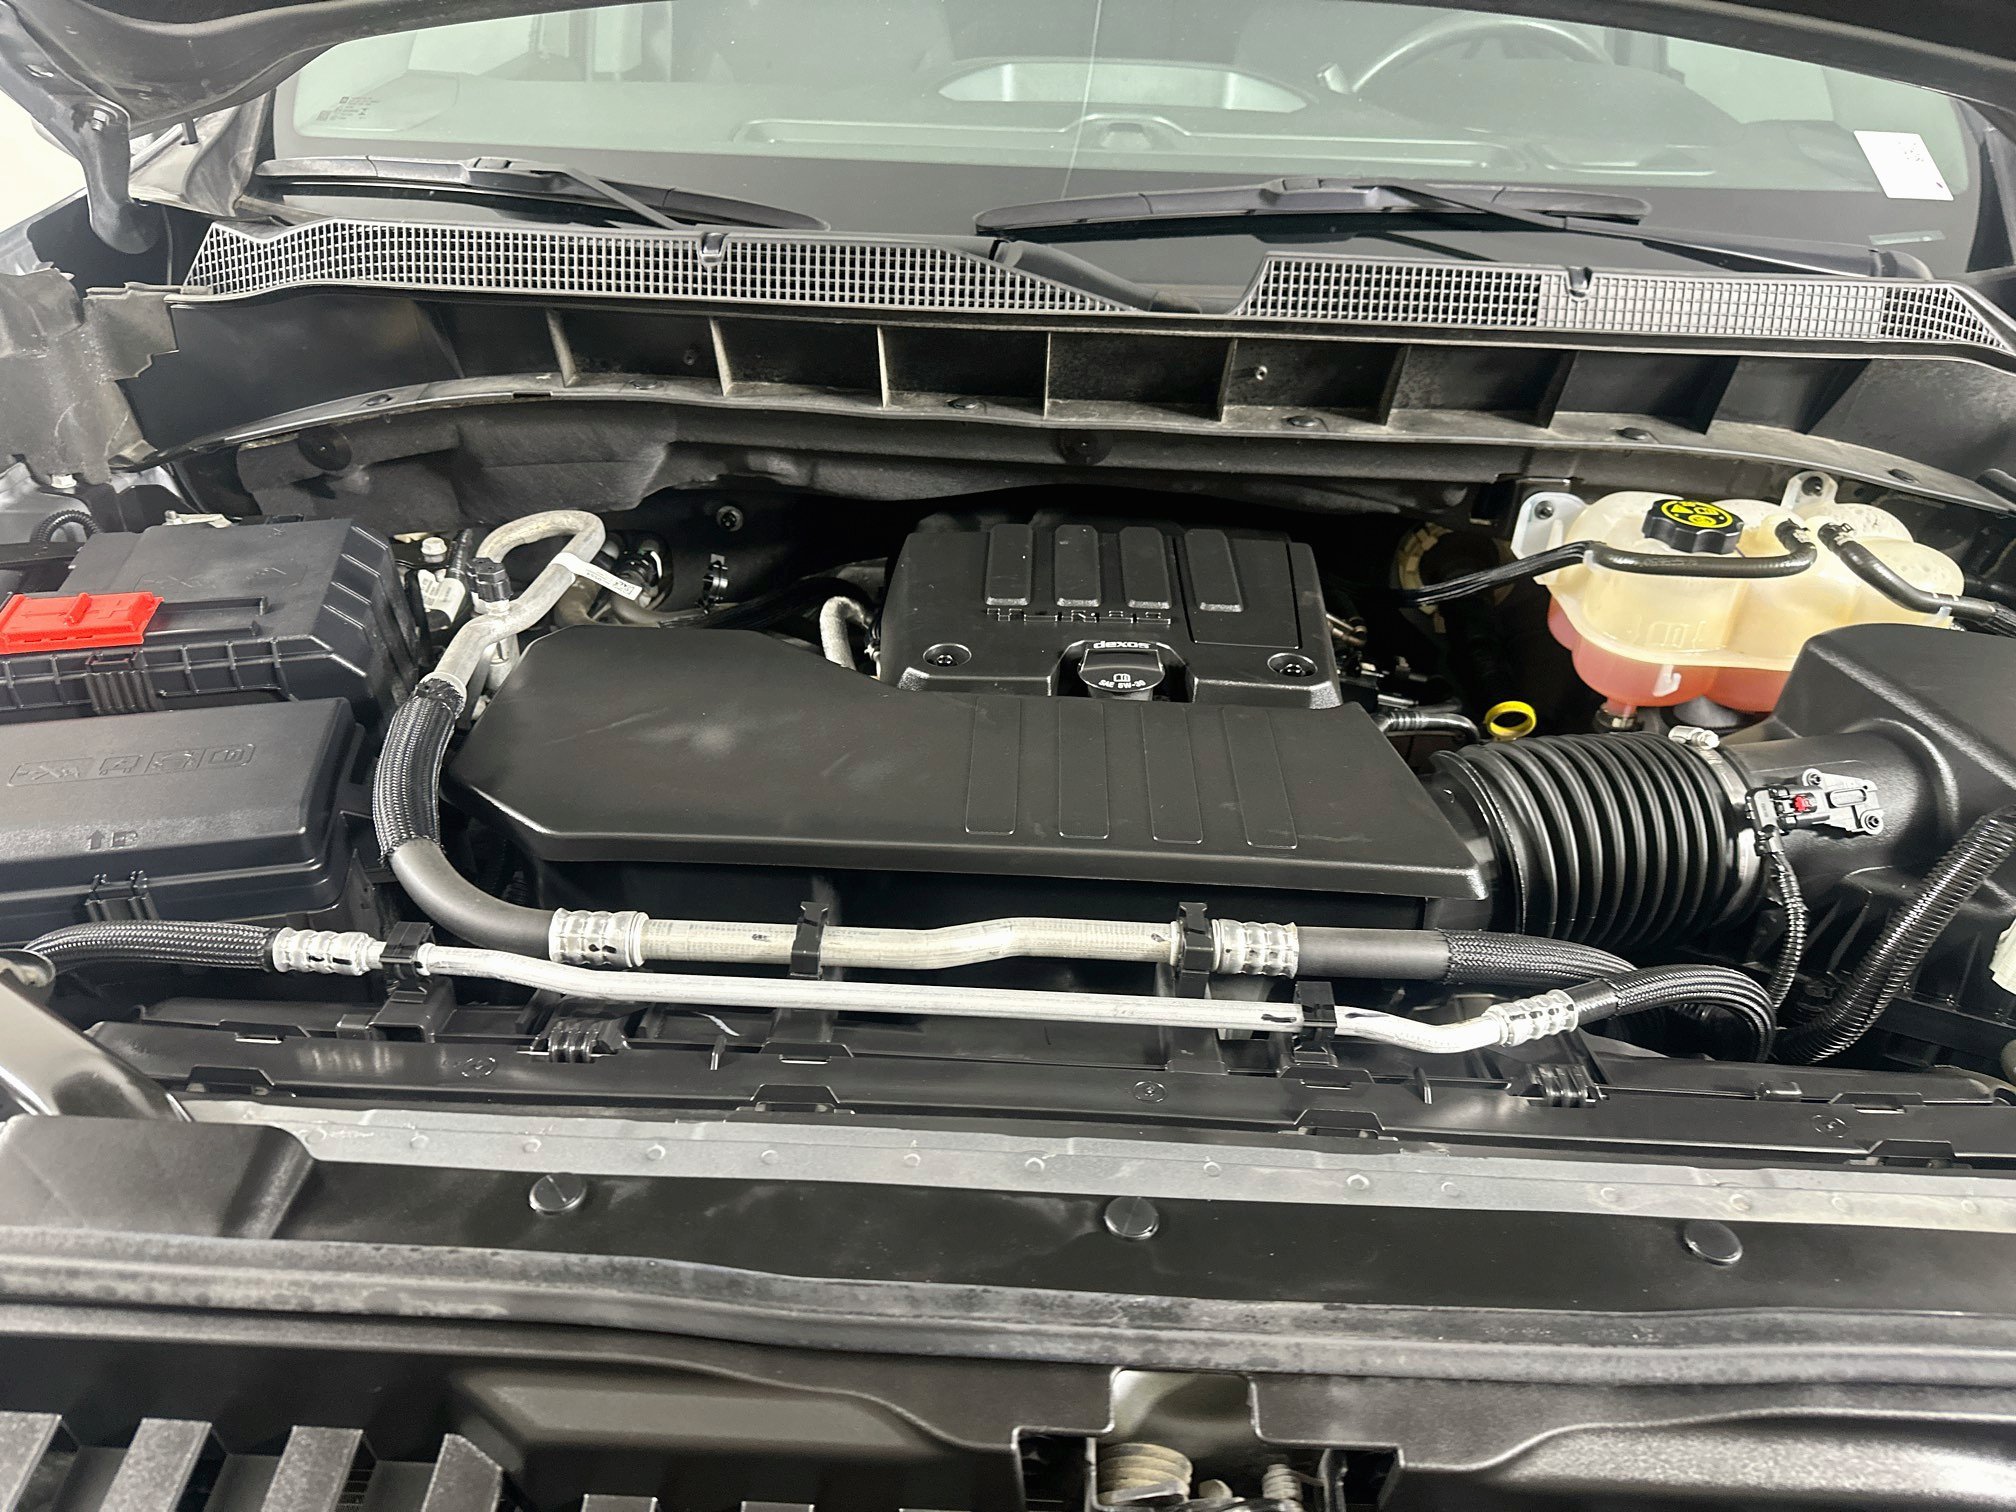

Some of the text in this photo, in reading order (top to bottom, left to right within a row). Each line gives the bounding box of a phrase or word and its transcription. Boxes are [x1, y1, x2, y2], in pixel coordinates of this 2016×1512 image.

[1093, 641, 1150, 649] dexos
[1098, 679, 1146, 689] SAE 5W-30
